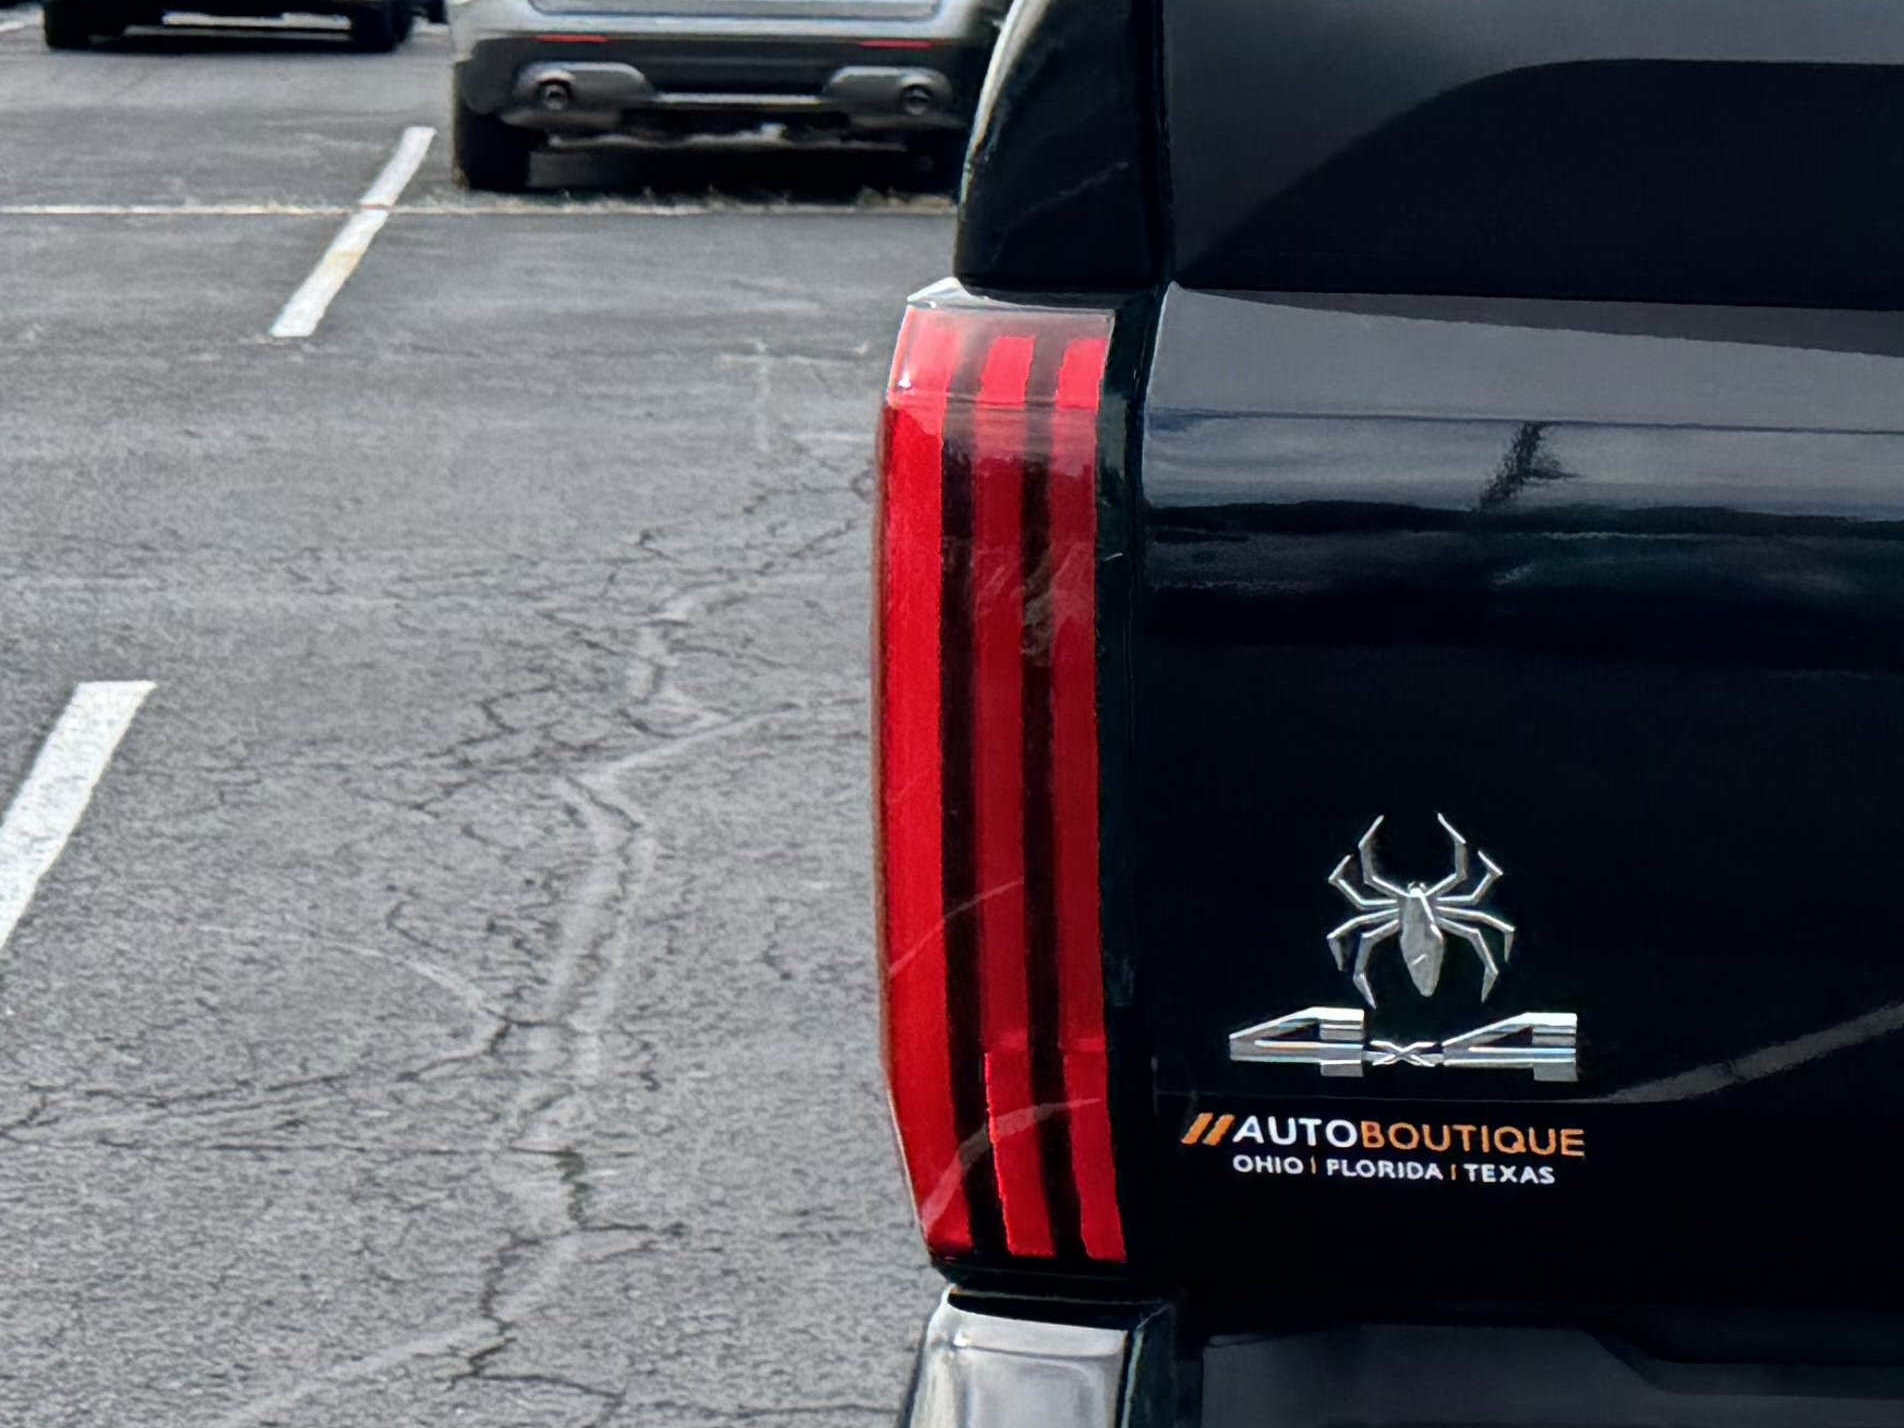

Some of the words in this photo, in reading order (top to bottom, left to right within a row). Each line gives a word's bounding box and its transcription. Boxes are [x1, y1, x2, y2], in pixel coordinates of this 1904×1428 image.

[1232, 1115, 1585, 1157] AUTOBOUTIQUE
[1233, 1154, 1304, 1175] OHIO
[1327, 1158, 1443, 1180] FLORIDA
[1463, 1163, 1556, 1184] TEXAS
